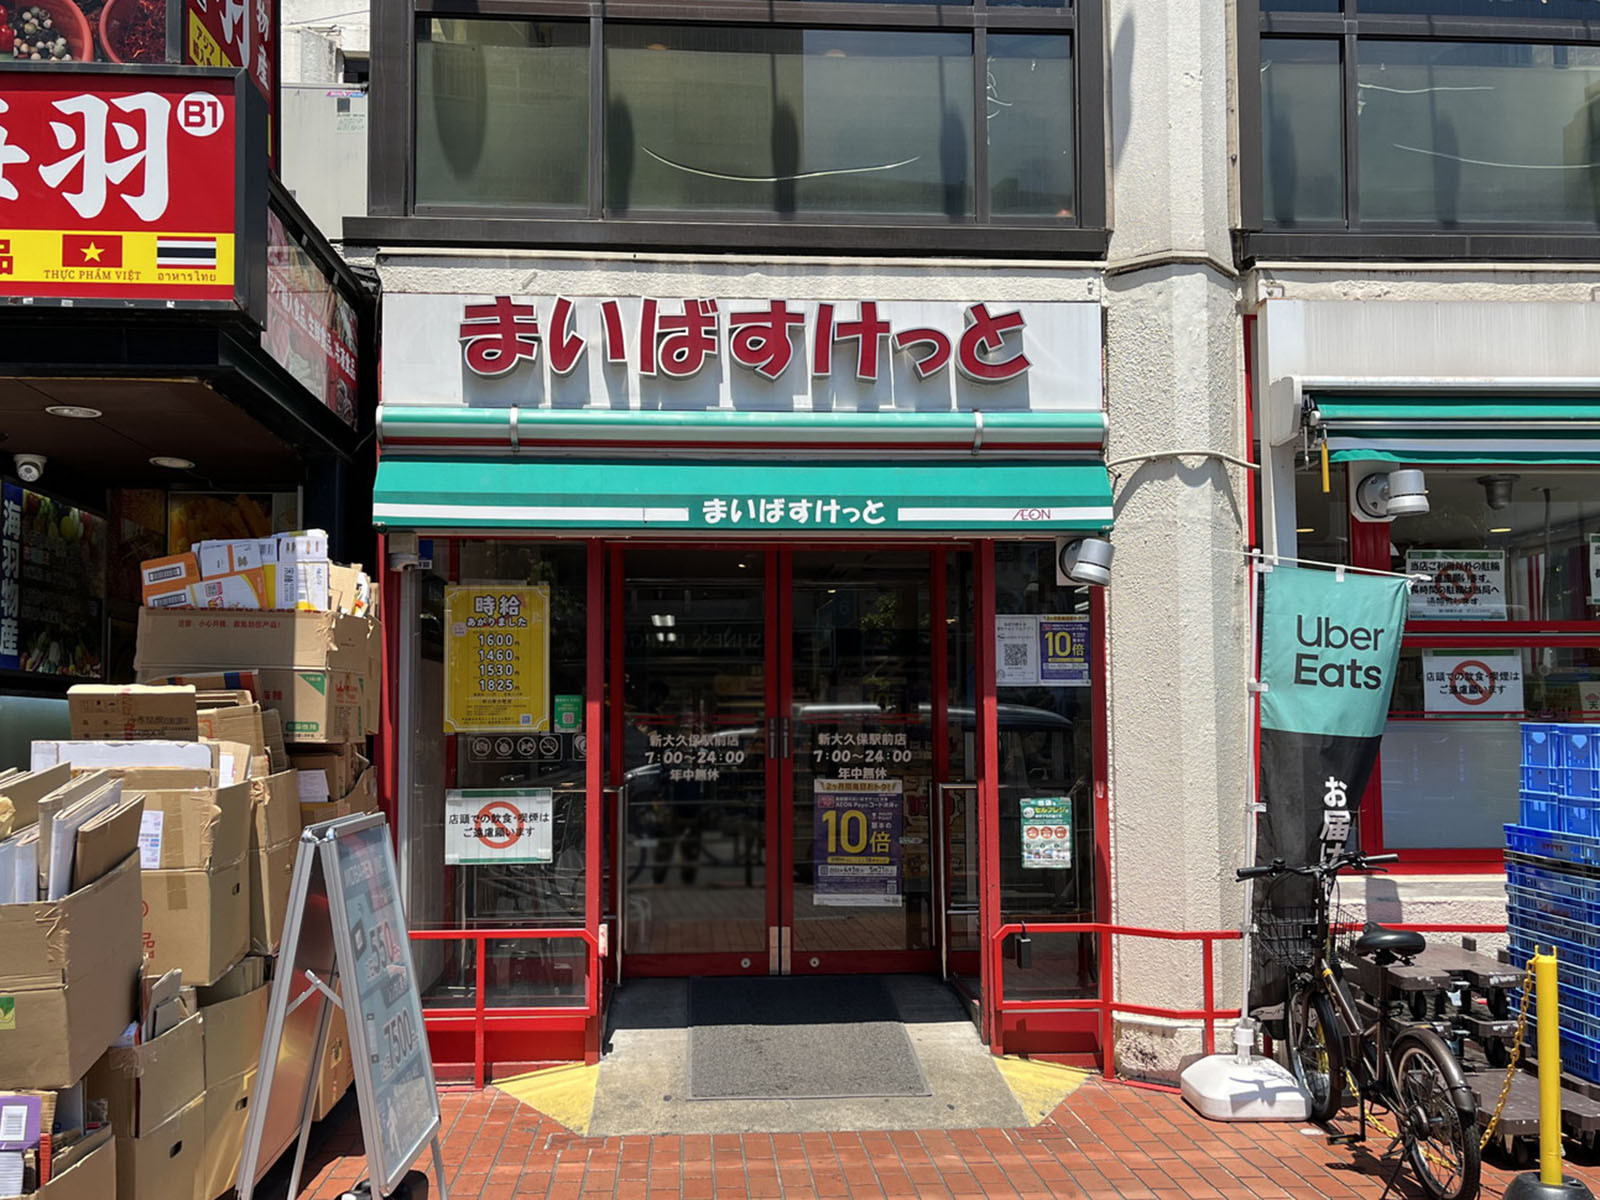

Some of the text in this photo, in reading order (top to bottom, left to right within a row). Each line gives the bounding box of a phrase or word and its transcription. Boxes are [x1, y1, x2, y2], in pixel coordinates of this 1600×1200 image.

[183, 101, 218, 128] B1
[157, 270, 217, 282] อาหารไทย
[458, 295, 1034, 384] まいばすけっと
[702, 498, 887, 526] まいばすけっと
[474, 595, 521, 616] 時給
[466, 617, 527, 628] あがりました
[1296, 614, 1385, 651] Uber
[1293, 653, 1383, 690] Eats
[649, 733, 740, 748] 新大久保駅前店
[818, 733, 907, 746] 新大久保駅前店
[669, 768, 720, 781] 年中無休
[838, 767, 888, 779] 年中無休
[449, 812, 550, 825] 店頭での飲食・喫煙は
[462, 826, 536, 839] ご遠慮願います
